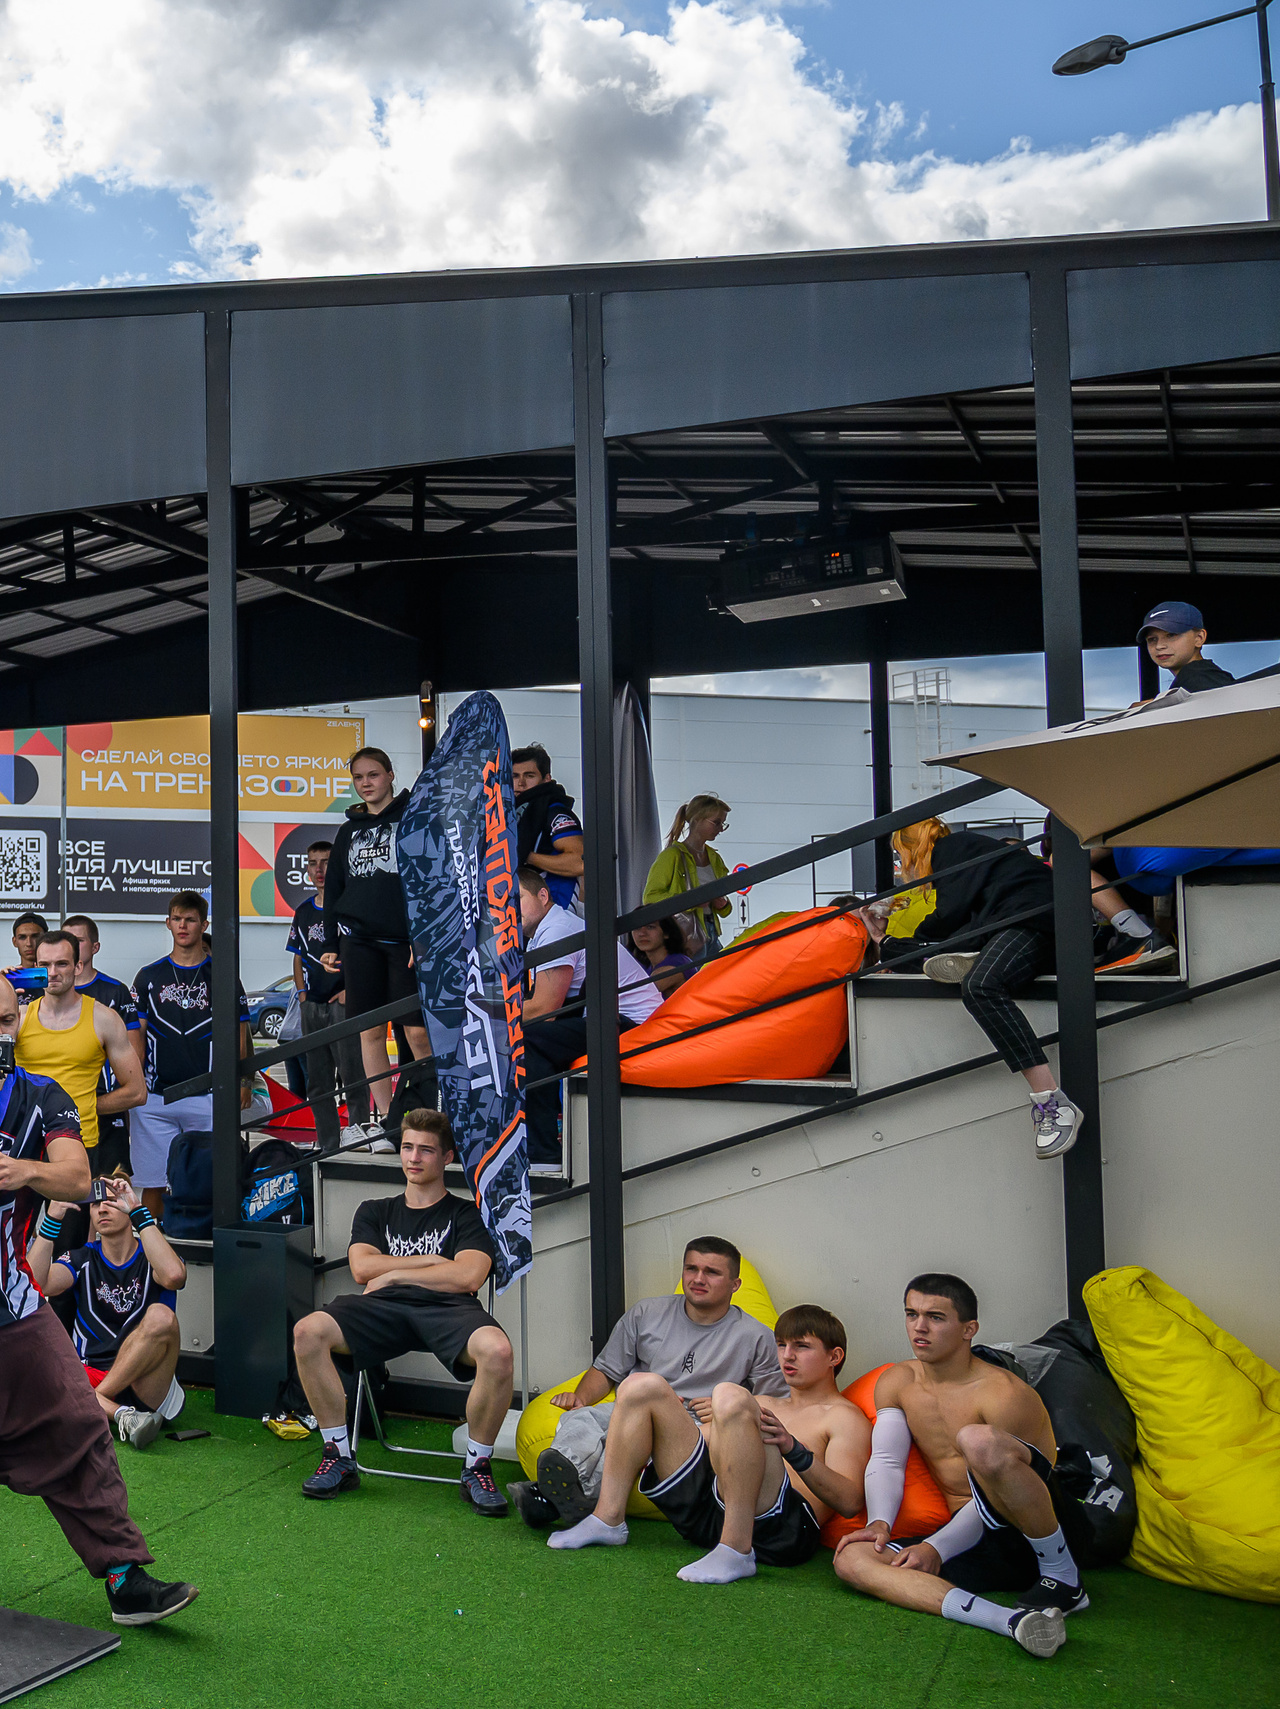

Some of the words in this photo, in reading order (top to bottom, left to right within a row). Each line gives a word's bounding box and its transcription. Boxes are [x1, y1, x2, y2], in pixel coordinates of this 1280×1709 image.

[81, 749, 163, 765] СДЕЛАЙ
[168, 752, 211, 767] СВО
[237, 754, 280, 769] ЕТО
[81, 769, 128, 792] НА
[58, 840, 105, 855] ВСЕ
[58, 858, 105, 875] ДЛЯ
[58, 876, 116, 891] ЛЕТА
[248, 1172, 296, 1217] NIKE
